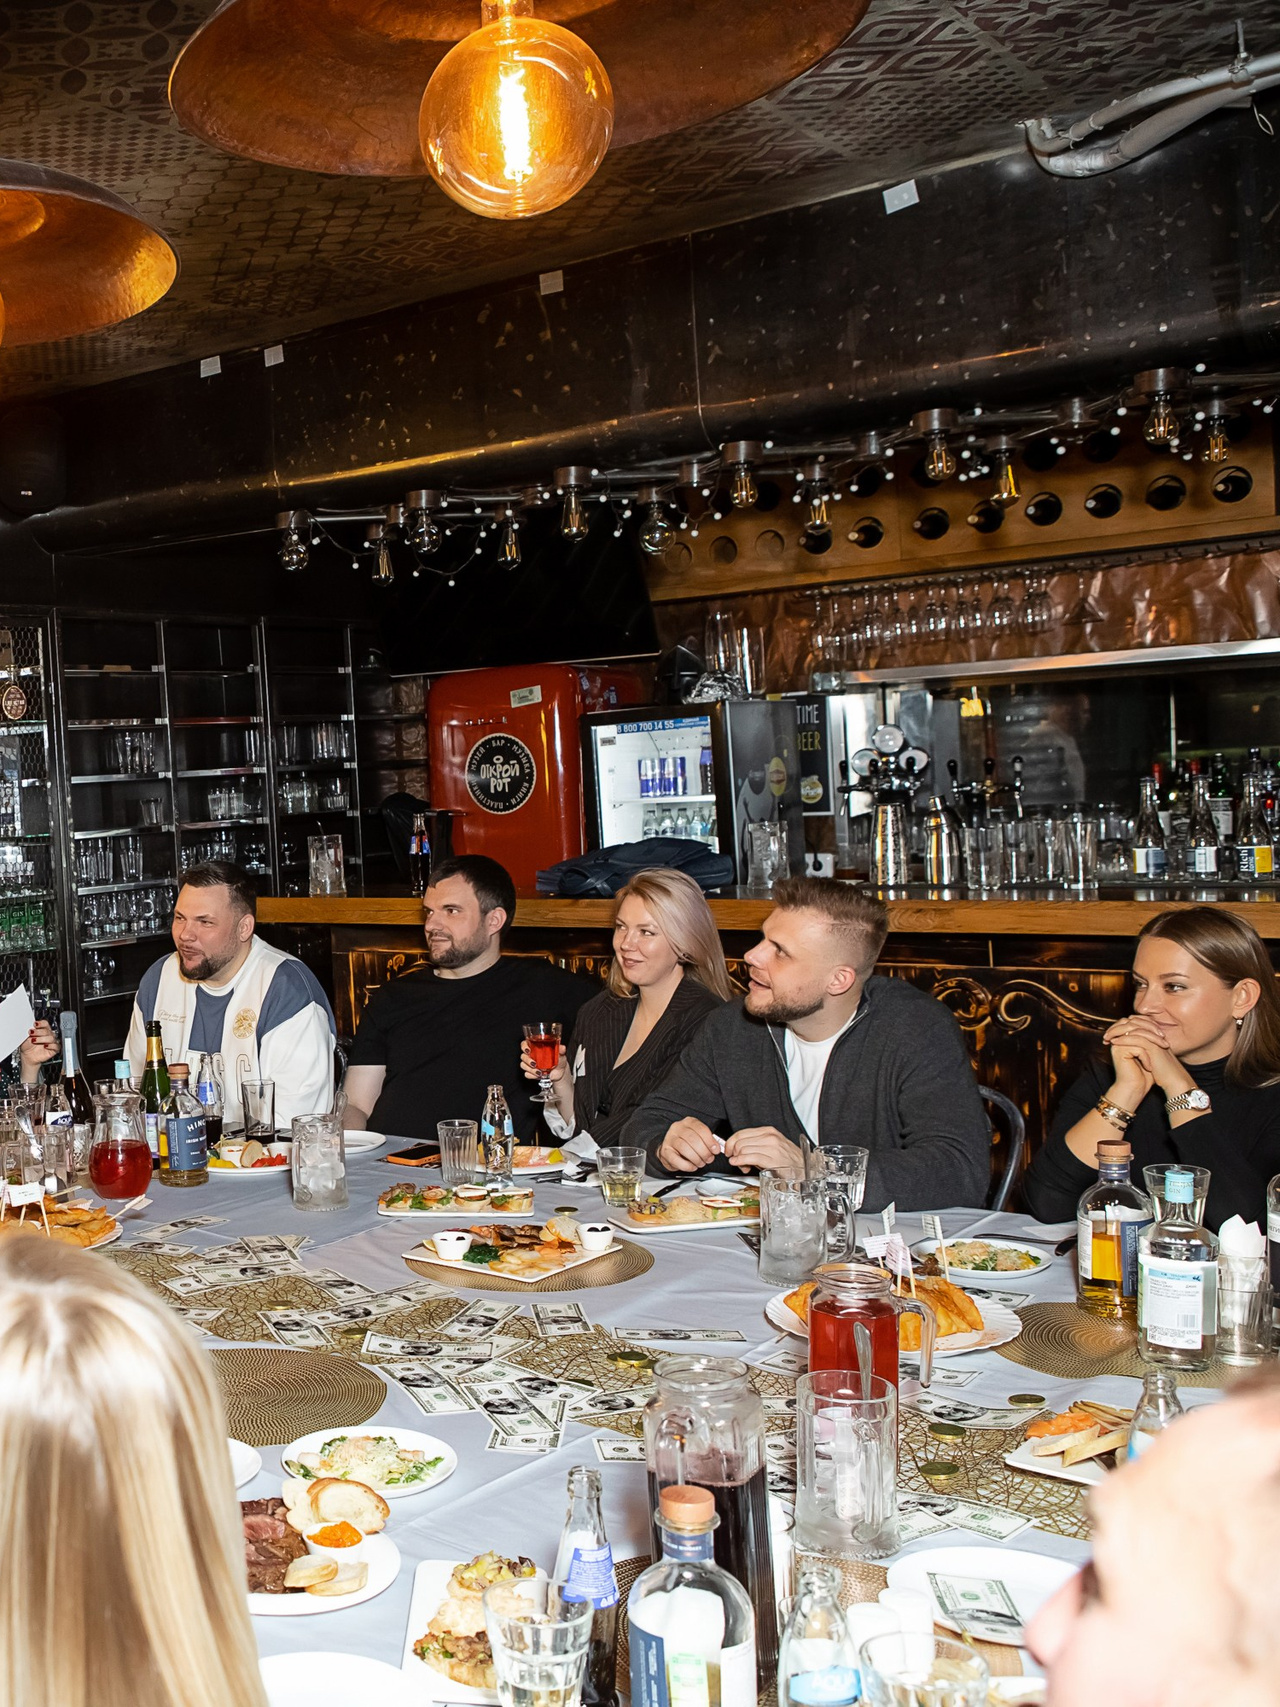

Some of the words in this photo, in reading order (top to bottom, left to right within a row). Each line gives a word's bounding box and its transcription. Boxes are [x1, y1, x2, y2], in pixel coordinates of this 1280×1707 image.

[796, 704, 820, 725] TIME
[624, 723, 638, 732] 800
[639, 722, 653, 731] 700
[655, 720, 663, 729] 14
[665, 719, 674, 728] 55
[480, 755, 520, 779] ОТКРОЙ
[490, 778, 511, 794] РОТ
[1240, 849, 1249, 871] Rich
[187, 1118, 206, 1132] HINC
